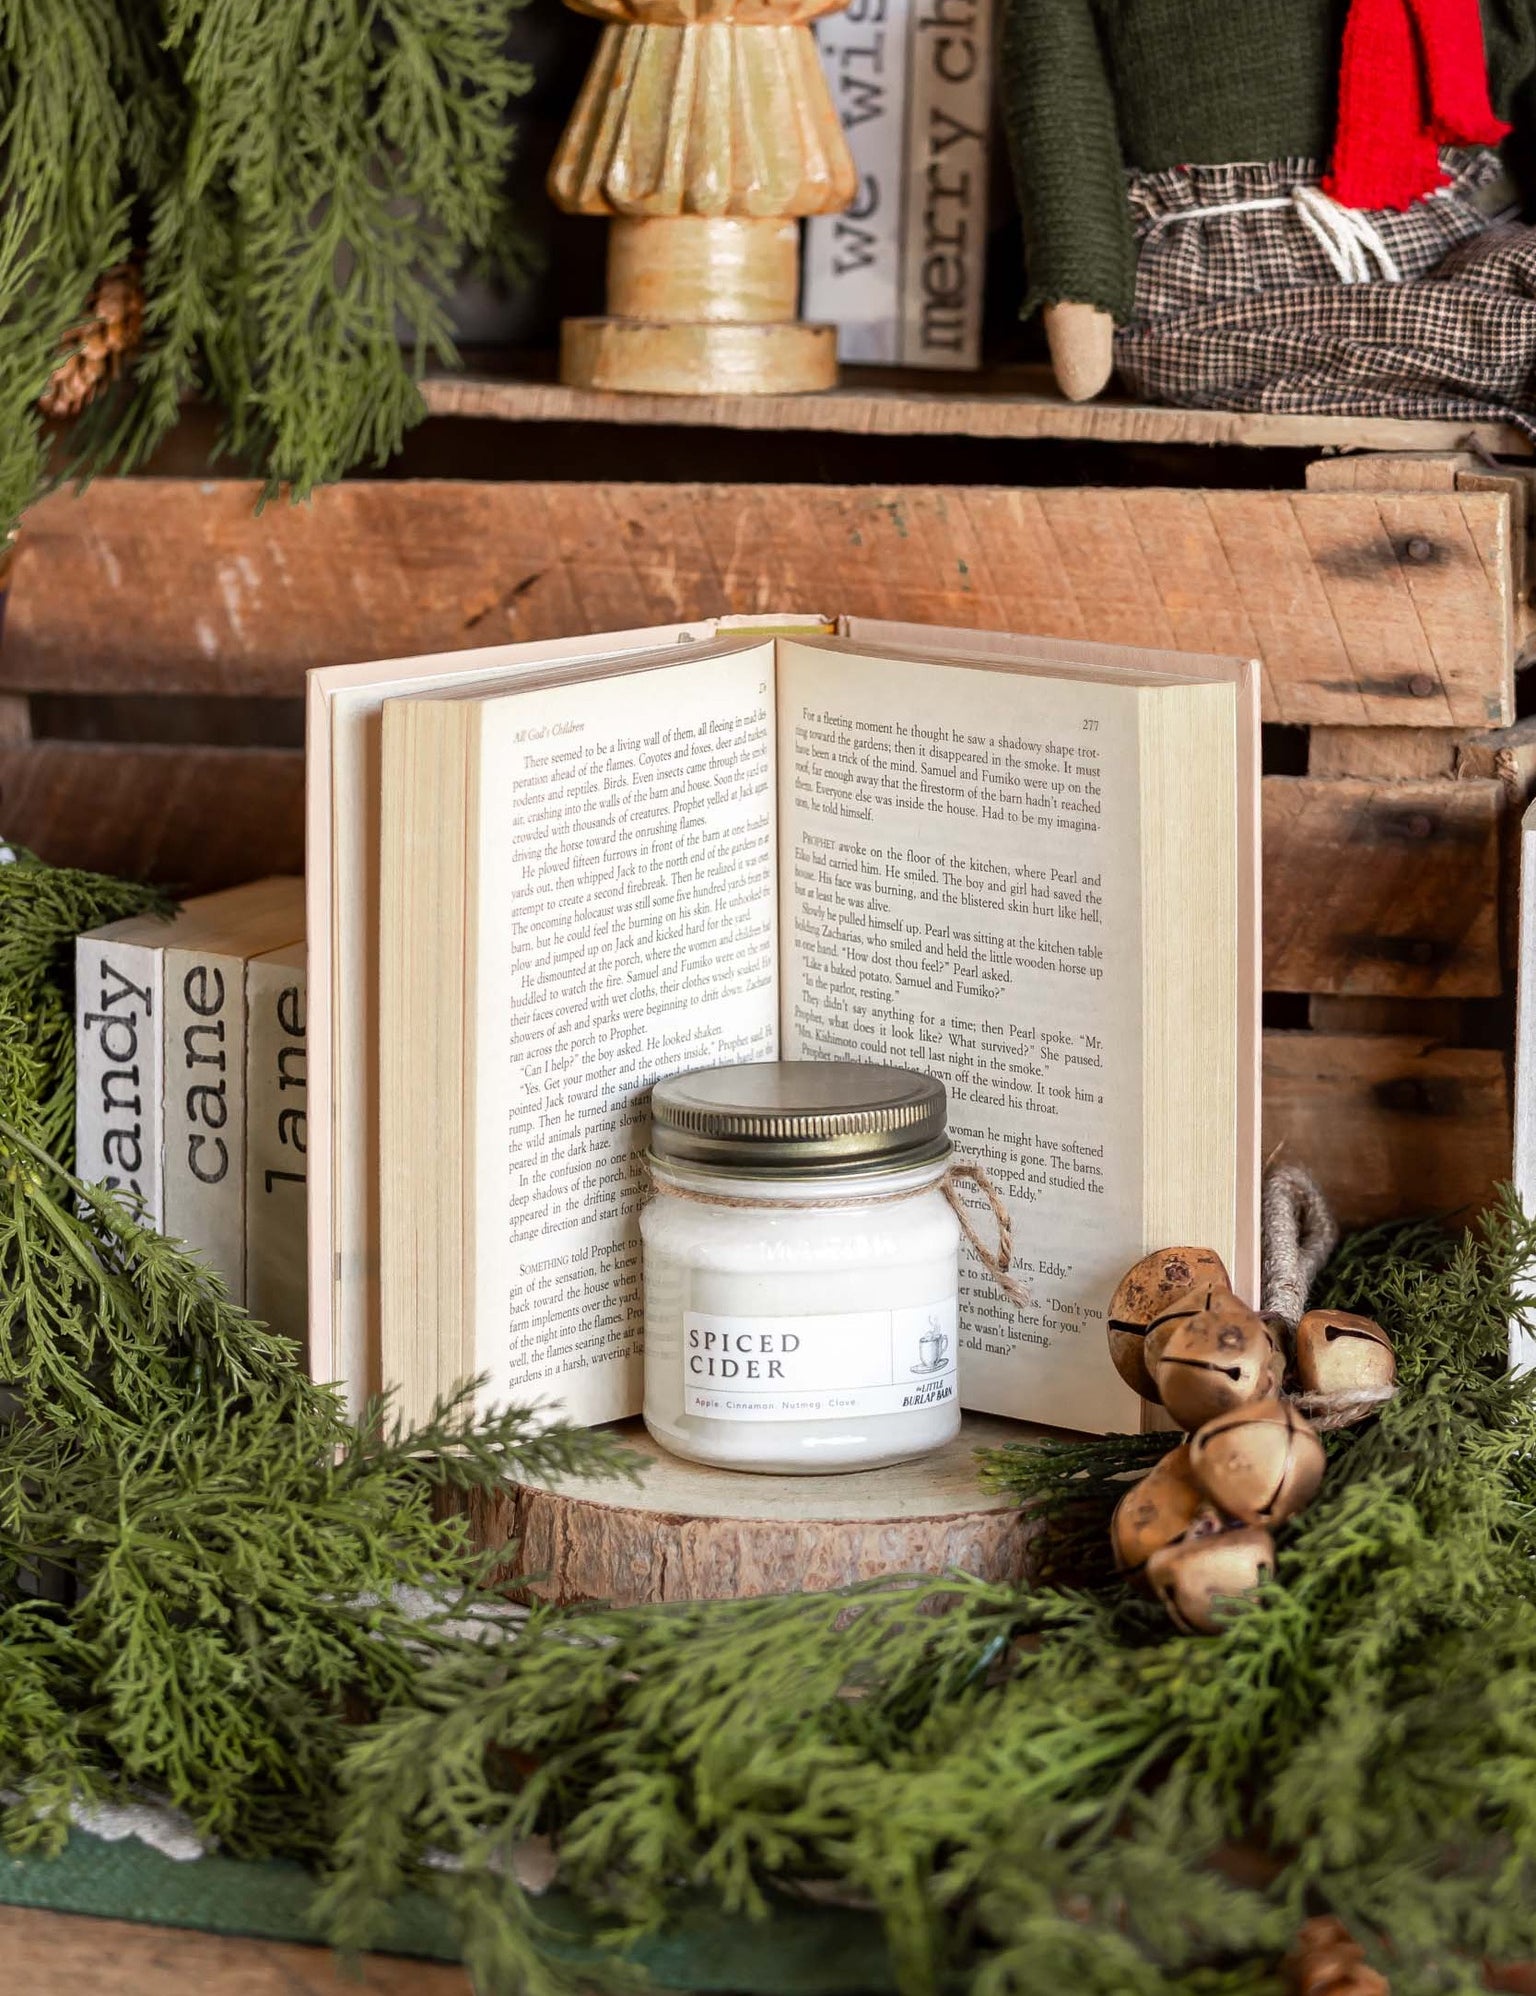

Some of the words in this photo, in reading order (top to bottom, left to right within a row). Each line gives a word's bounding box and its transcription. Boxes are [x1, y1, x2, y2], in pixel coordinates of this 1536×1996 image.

[920, 106, 985, 352] merry
[823, 710, 852, 731] fleeting
[855, 721, 892, 734] moment
[896, 722, 907, 736] he
[911, 724, 948, 742] thought
[952, 729, 964, 743] he
[967, 735, 985, 745] saw
[989, 738, 994, 746] a
[998, 735, 1042, 755] shadowy
[1044, 740, 1074, 758] shape
[1077, 747, 1099, 758] trot-
[1083, 719, 1099, 731] 277
[838, 841, 866, 855] awoke
[870, 848, 882, 858] on
[886, 846, 902, 860] the
[906, 848, 931, 864] floor
[934, 853, 945, 866] of
[950, 855, 965, 869] the
[969, 857, 1010, 876] kitchen,
[1014, 864, 1046, 879] where
[1050, 868, 1077, 883] Pearl
[1081, 873, 1101, 886] and
[510, 958, 532, 975] plow
[534, 951, 550, 967] and
[553, 943, 584, 965] jumped
[587, 945, 598, 957] up
[600, 942, 612, 952] on
[616, 934, 633, 950] Jack
[636, 930, 653, 945] and
[656, 923, 683, 941] kicked
[685, 919, 704, 935] hard
[707, 919, 718, 930] for
[720, 914, 733, 927] the
[826, 907, 836, 921] he
[838, 910, 865, 926] pulled
[868, 914, 903, 932] himself
[905, 924, 921, 936] up.
[925, 923, 949, 938] Pearl
[952, 930, 971, 941] was
[973, 930, 1004, 949] sitting
[1006, 938, 1015, 947] at
[1019, 935, 1035, 950] the
[1037, 937, 1075, 955] kitchen
[1078, 944, 1103, 959] table
[823, 994, 848, 1011] didn't
[852, 1005, 867, 1017] say
[871, 1006, 914, 1025] anything
[920, 1010, 935, 1024] for
[940, 1018, 945, 1026] a
[951, 1016, 976, 1032] time;
[981, 1019, 1003, 1035] then
[1009, 1024, 1035, 1039] Pearl
[1040, 1030, 1073, 1045] spoke.
[509, 1052, 523, 1063] ran
[526, 1046, 552, 1059] across
[554, 1039, 568, 1052] the
[570, 1032, 595, 1052] porch
[598, 1033, 607, 1043] to
[544, 1060, 548, 1072] I
[581, 1050, 595, 1064] the
[597, 1048, 614, 1060] boy
[646, 1036, 660, 1050] He
[662, 1028, 691, 1047] looked
[183, 964, 229, 1184] cane
[951, 1086, 966, 1100] He
[969, 1089, 1005, 1106] cleared
[1008, 1094, 1022, 1108] his
[1025, 1097, 1058, 1114] throat.
[948, 1125, 984, 1138] woman
[987, 1126, 1000, 1141] he
[1003, 1132, 1032, 1147] might
[1035, 1134, 1058, 1150] have
[1061, 1140, 1103, 1157] softened
[953, 1140, 1006, 1162] Everything
[1009, 1148, 1017, 1161] is
[1020, 1154, 1046, 1166] gone.
[1049, 1155, 1070, 1170] The
[1072, 1158, 1103, 1175] barns.
[985, 1166, 1025, 1181] stopped
[1027, 1171, 1046, 1184] and
[1048, 1175, 1085, 1190] studied
[1087, 1179, 1104, 1193] the
[520, 1258, 568, 1276] SOMETHING
[571, 1247, 588, 1262] told
[591, 1240, 625, 1258] Prophet
[628, 1239, 638, 1250] to
[1012, 1256, 1035, 1272] Mrs.
[509, 1286, 522, 1300] gin
[526, 1280, 534, 1292] of
[538, 1276, 551, 1289] the
[600, 1260, 611, 1273] he
[614, 1255, 637, 1269] knew
[509, 1298, 529, 1315] back
[533, 1288, 563, 1307] toward
[566, 1286, 580, 1299] the
[583, 1281, 609, 1295] house
[612, 1273, 636, 1287] when
[509, 1319, 529, 1333] farm
[531, 1306, 579, 1327] implements
[581, 1301, 600, 1313] over
[602, 1295, 616, 1308] the
[974, 1319, 1004, 1337] wasn't
[976, 1305, 1014, 1324] nothing
[1017, 1310, 1039, 1326] here
[1042, 1314, 1057, 1328] for
[1083, 1308, 1102, 1319] you
[689, 1329, 800, 1353] SPICED
[966, 1336, 981, 1350] old
[508, 1369, 542, 1389] gardens
[544, 1367, 552, 1376] in
[555, 1365, 560, 1374] a
[562, 1354, 588, 1372] harsh,
[591, 1347, 630, 1363] wavering
[690, 1355, 785, 1378] CIDER
[902, 1391, 936, 1407] BURLAP
[936, 1385, 953, 1401] BARN
[922, 1379, 944, 1393] LITTLE
